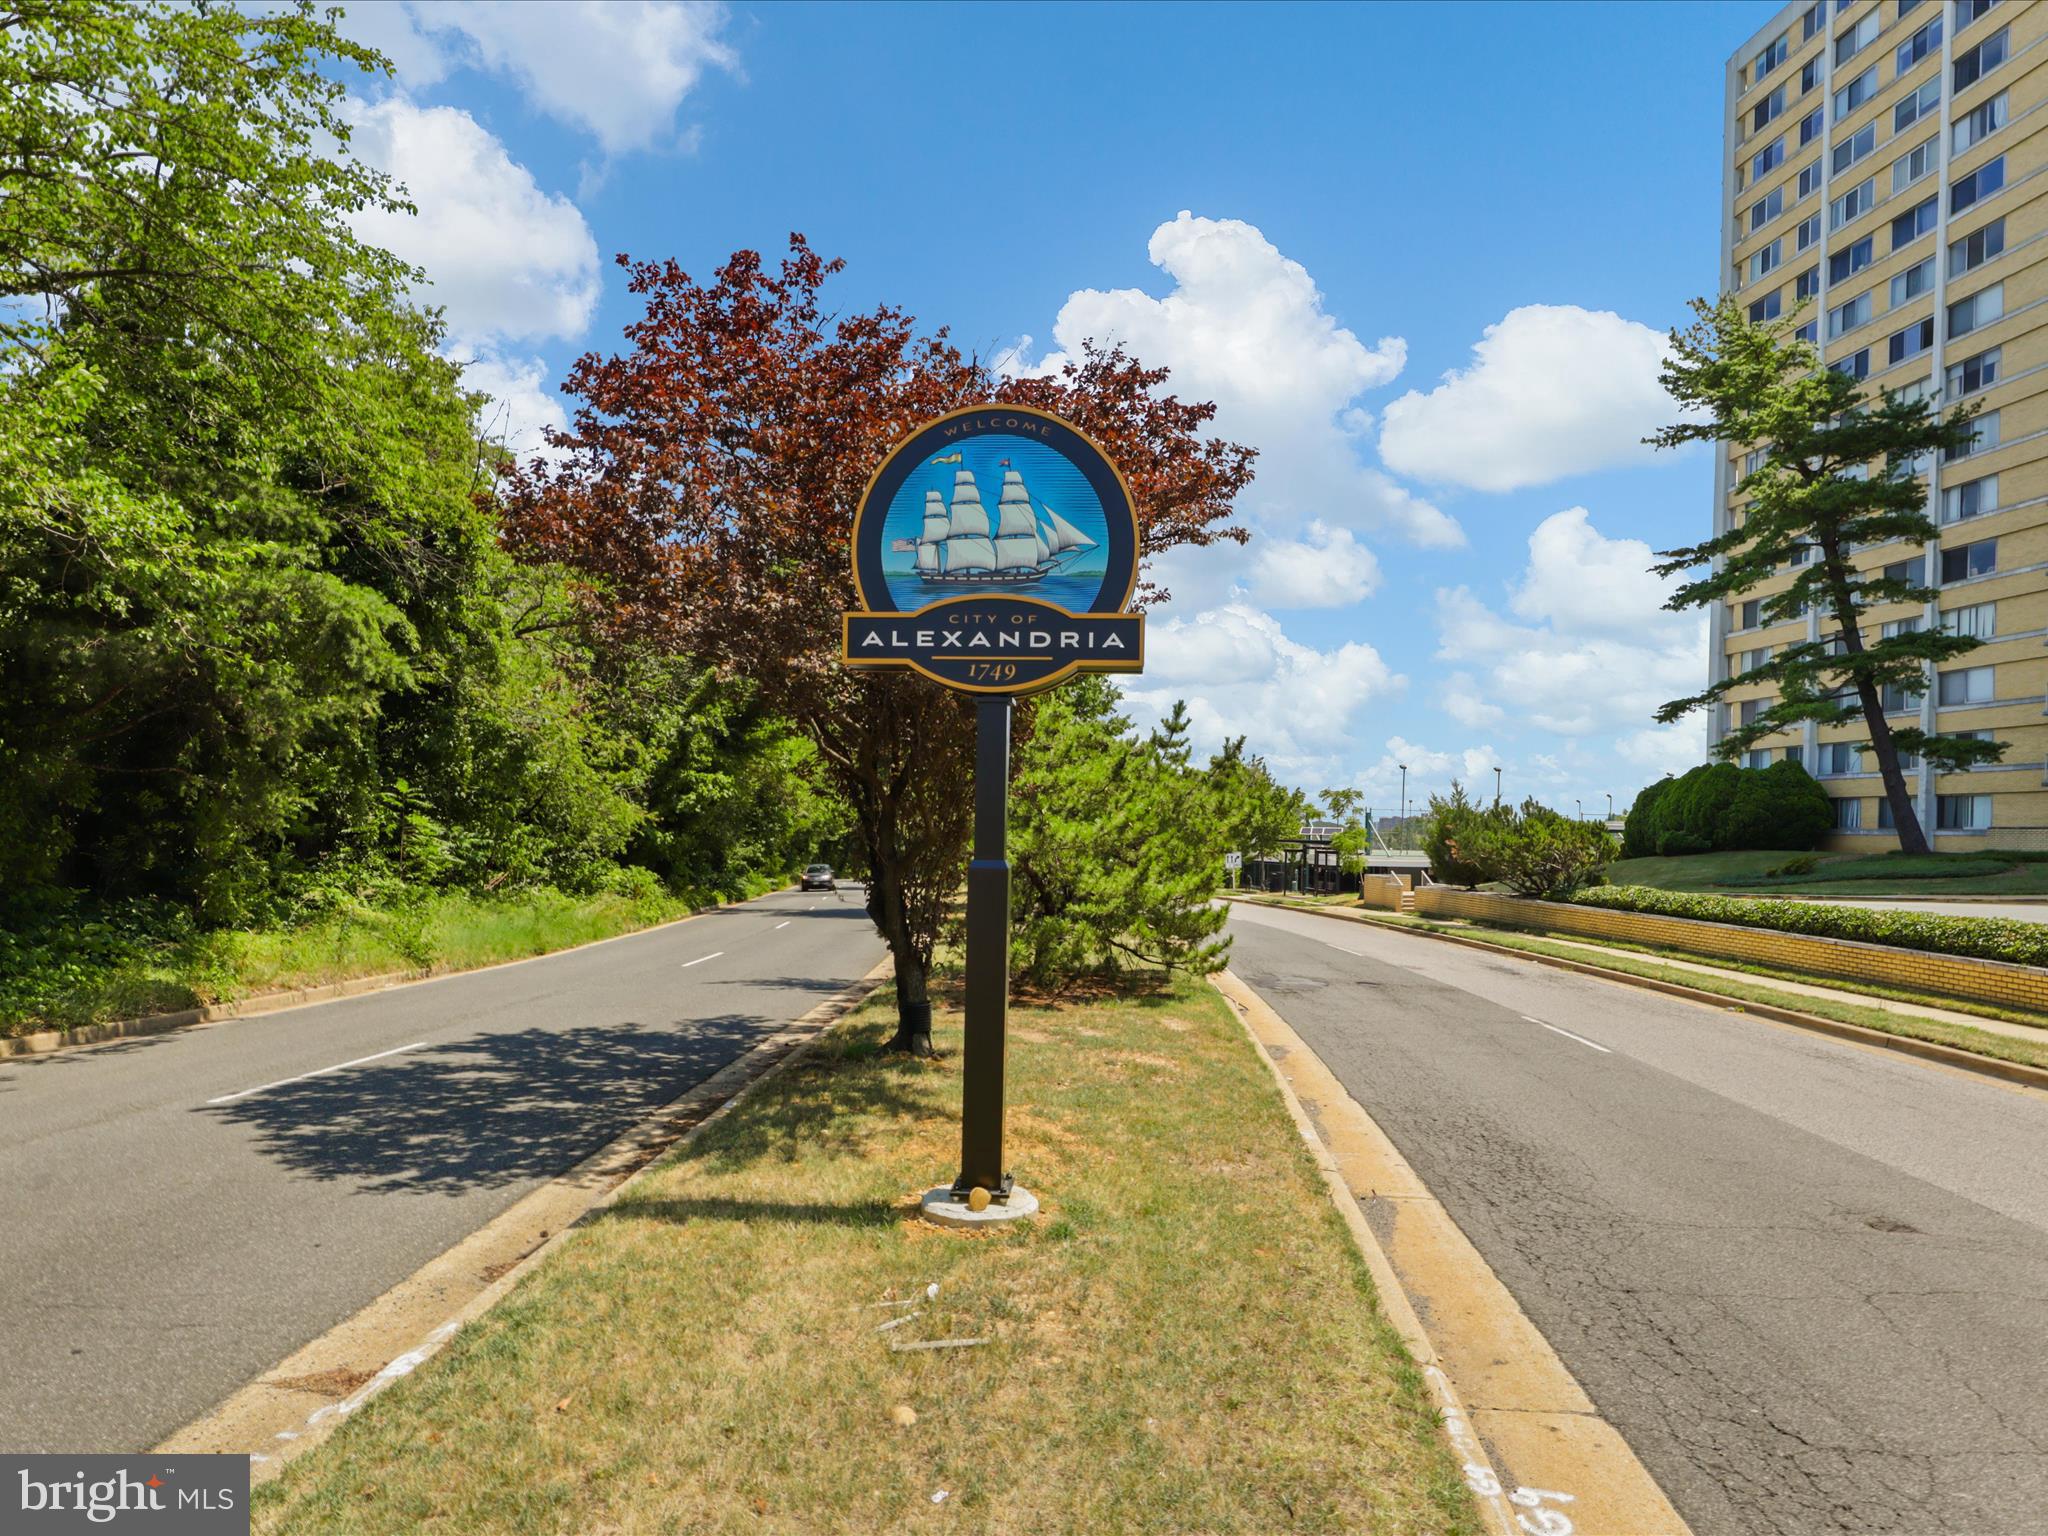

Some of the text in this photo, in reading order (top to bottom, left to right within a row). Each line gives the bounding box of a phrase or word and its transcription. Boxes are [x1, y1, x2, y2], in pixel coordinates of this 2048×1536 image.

[944, 417, 1051, 436] WELCOME
[948, 614, 1038, 624] CITY OF
[861, 630, 1125, 648] ALEXANDRIA
[967, 663, 1016, 680] 1749
